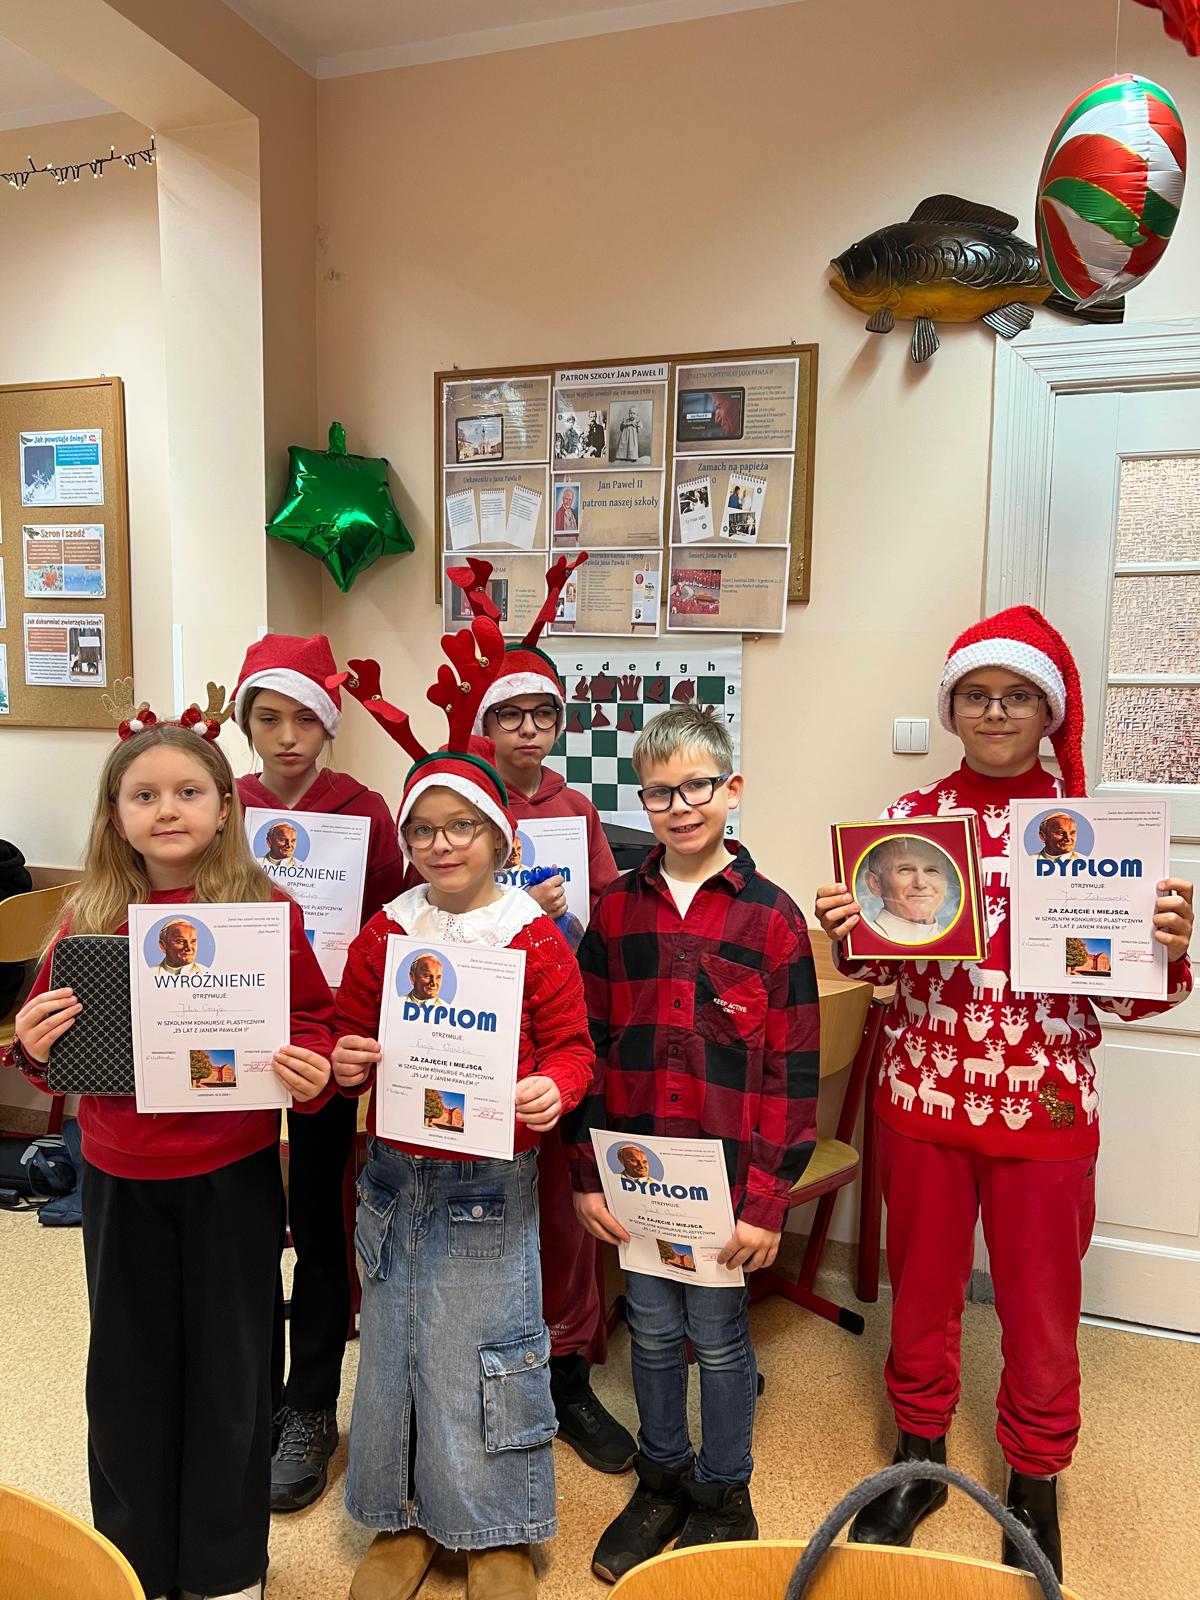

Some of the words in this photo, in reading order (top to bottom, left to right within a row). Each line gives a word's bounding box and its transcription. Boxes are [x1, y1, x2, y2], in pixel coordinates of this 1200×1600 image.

[560, 374, 588, 382] PATRON
[590, 372, 615, 380] SZKOŁY
[616, 370, 630, 378] JAN
[34, 436, 44, 444] Jak
[44, 435, 68, 444] powstaje
[70, 434, 87, 443] śnieg?
[698, 463, 726, 472] Zamach
[740, 462, 769, 473] papieża
[598, 480, 610, 491] Jan
[637, 480, 643, 488] II
[582, 499, 607, 510] patron
[609, 498, 633, 508] naszej
[634, 496, 659, 508] szkoły
[40, 529, 60, 538] Szron
[602, 662, 609, 671] d
[656, 662, 660, 671] f
[680, 664, 688, 673] g
[708, 662, 715, 671] h
[727, 685, 735, 695] 8
[727, 713, 735, 723] 7
[726, 826, 734, 835] 3
[263, 864, 346, 881] WYRÓŻNIENIE
[1036, 858, 1142, 877] DYPLOM
[494, 866, 570, 886] DYPM
[154, 971, 265, 988] WYRÓŻNIENIE
[713, 998, 728, 1006] KEEP
[728, 1003, 748, 1013] ACTIVE
[402, 1001, 497, 1032] DYPLOM
[420, 1058, 448, 1066] ZAJĘCIE
[454, 1062, 482, 1071] MIEJSCA
[404, 1064, 429, 1072] SZKOLNYM
[430, 1067, 458, 1076] KONKURSIE
[459, 1071, 494, 1080] PLASTYCZNYM
[452, 1078, 474, 1086] PAWŁEM
[621, 1178, 709, 1201] DYPLOM
